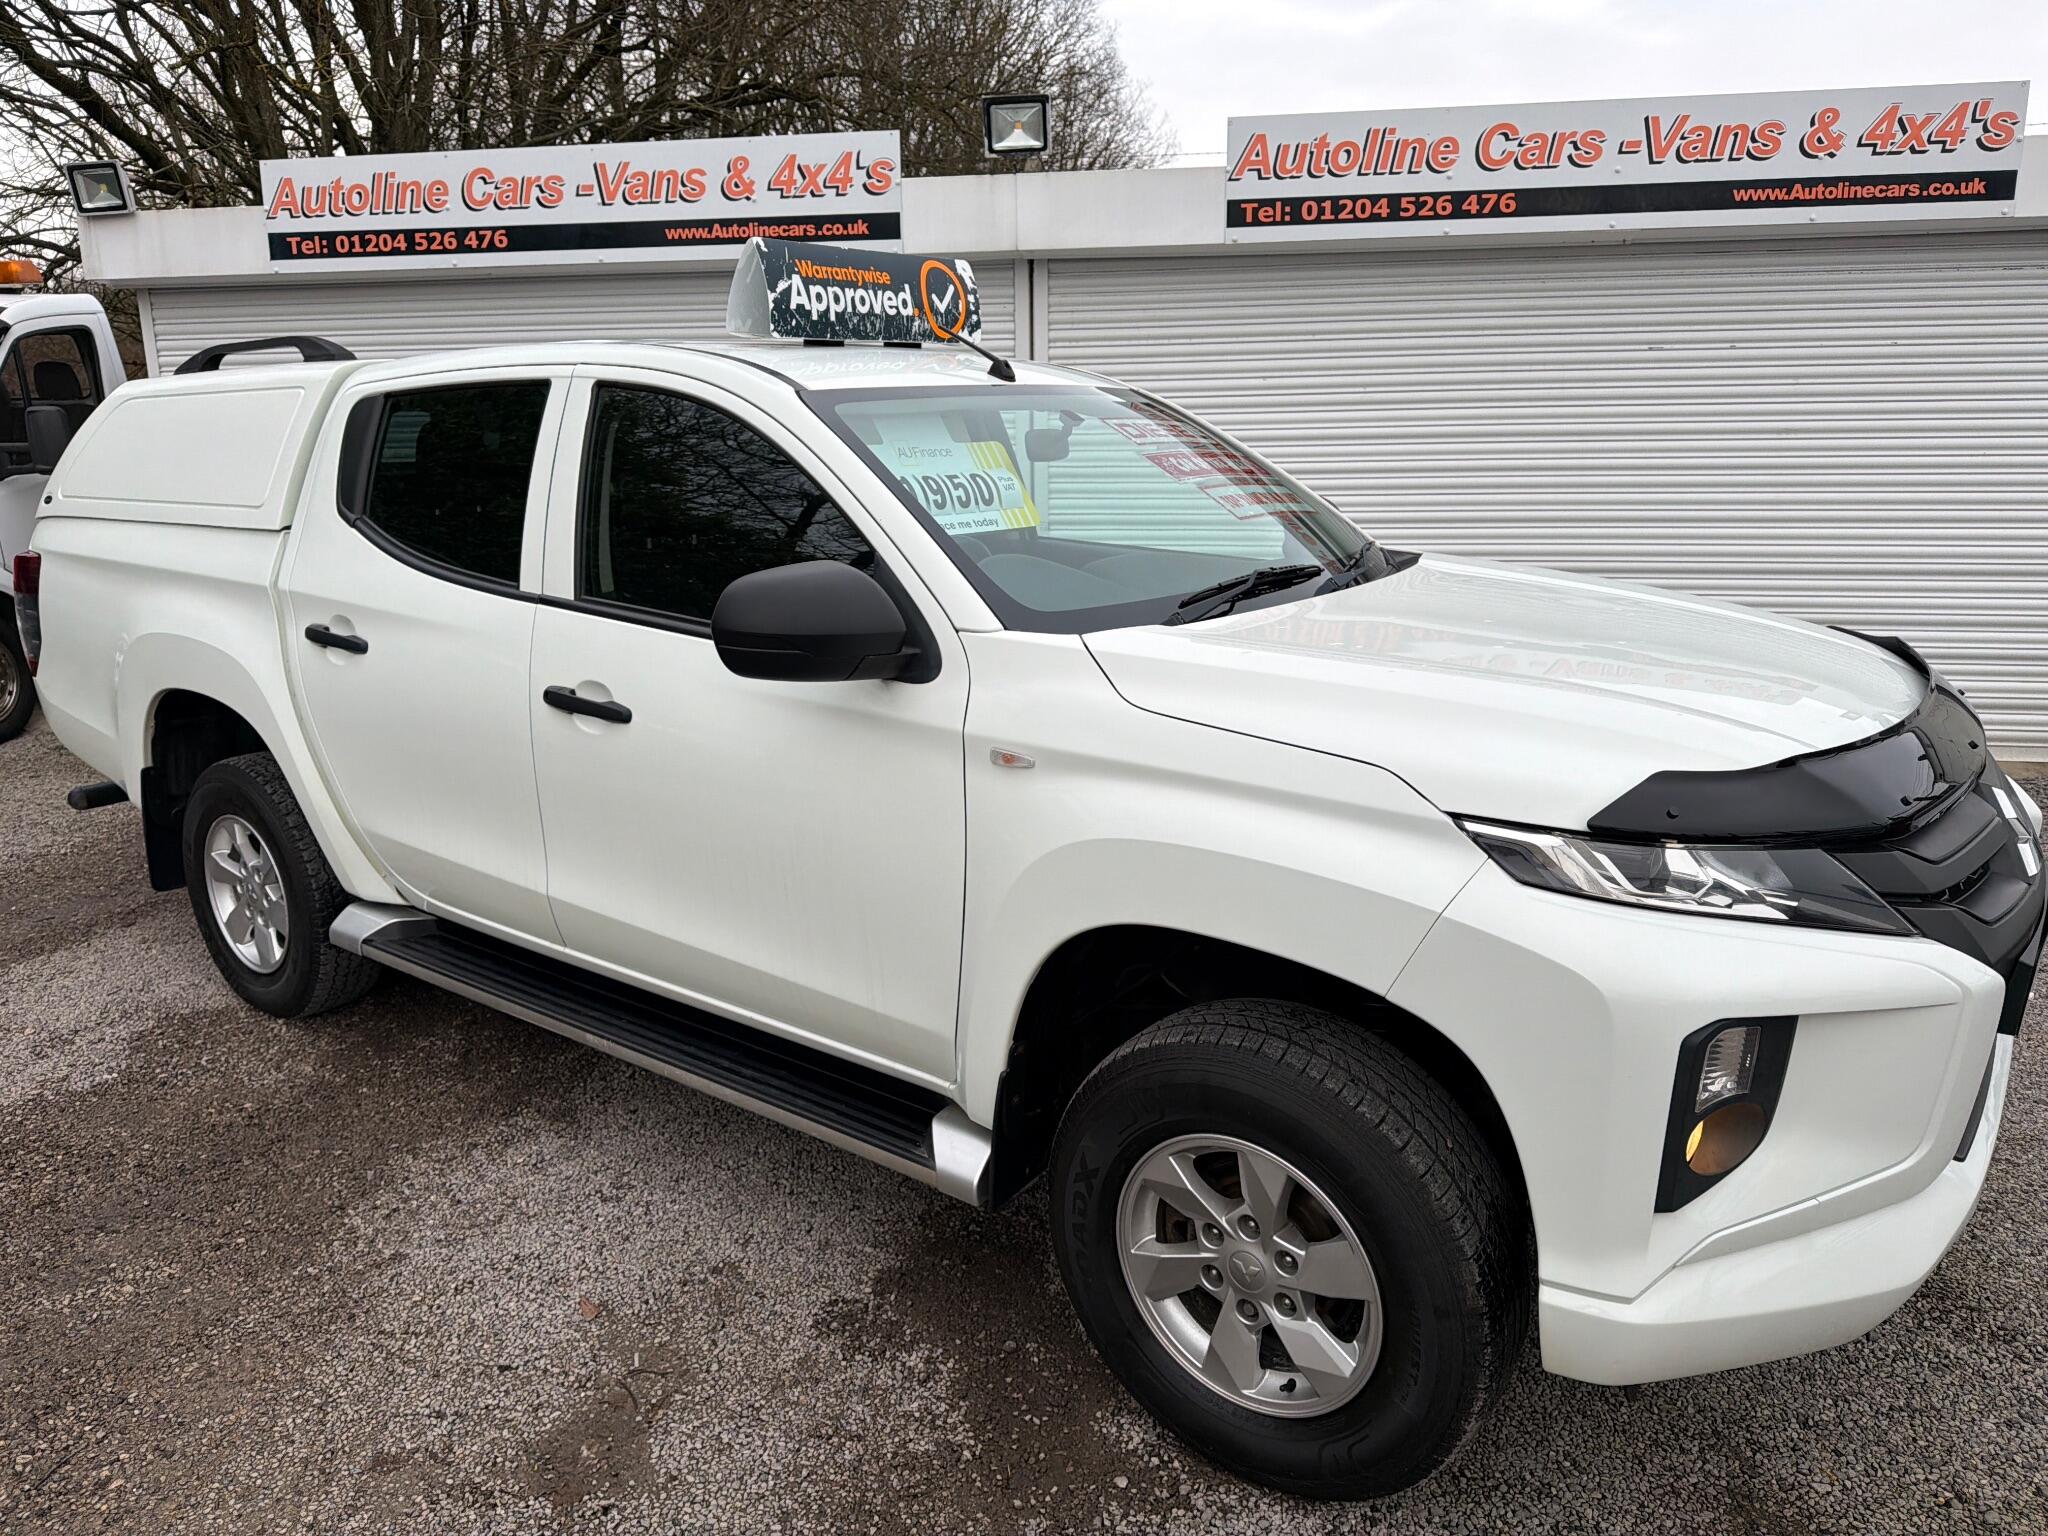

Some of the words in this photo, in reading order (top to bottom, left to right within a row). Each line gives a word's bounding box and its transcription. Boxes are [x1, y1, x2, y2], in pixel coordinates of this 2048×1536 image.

[1227, 127, 1460, 181] Autoline
[1475, 122, 1608, 171] Cars
[1799, 106, 1848, 159] &
[1857, 98, 2020, 156] 4x4's
[266, 171, 449, 219] Autoline
[462, 167, 566, 210] Cars
[721, 155, 756, 201] &
[767, 150, 896, 198] 4x4's
[1733, 177, 1987, 202] www.Autolinecars.co.uk
[1241, 201, 1291, 223] Tel:
[1301, 197, 1390, 221] 01204
[1400, 195, 1453, 217] 526
[1462, 192, 1517, 215] 476
[286, 235, 329, 255] Tel:
[335, 233, 408, 254] 01204
[414, 231, 457, 251] 526
[464, 229, 509, 249] 476
[665, 218, 869, 240] www.Autolinecars.co.uk
[795, 259, 891, 286] Warrantywise
[1002, 483, 1016, 491] VAT
[957, 520, 972, 529] me
[973, 517, 999, 528] today
